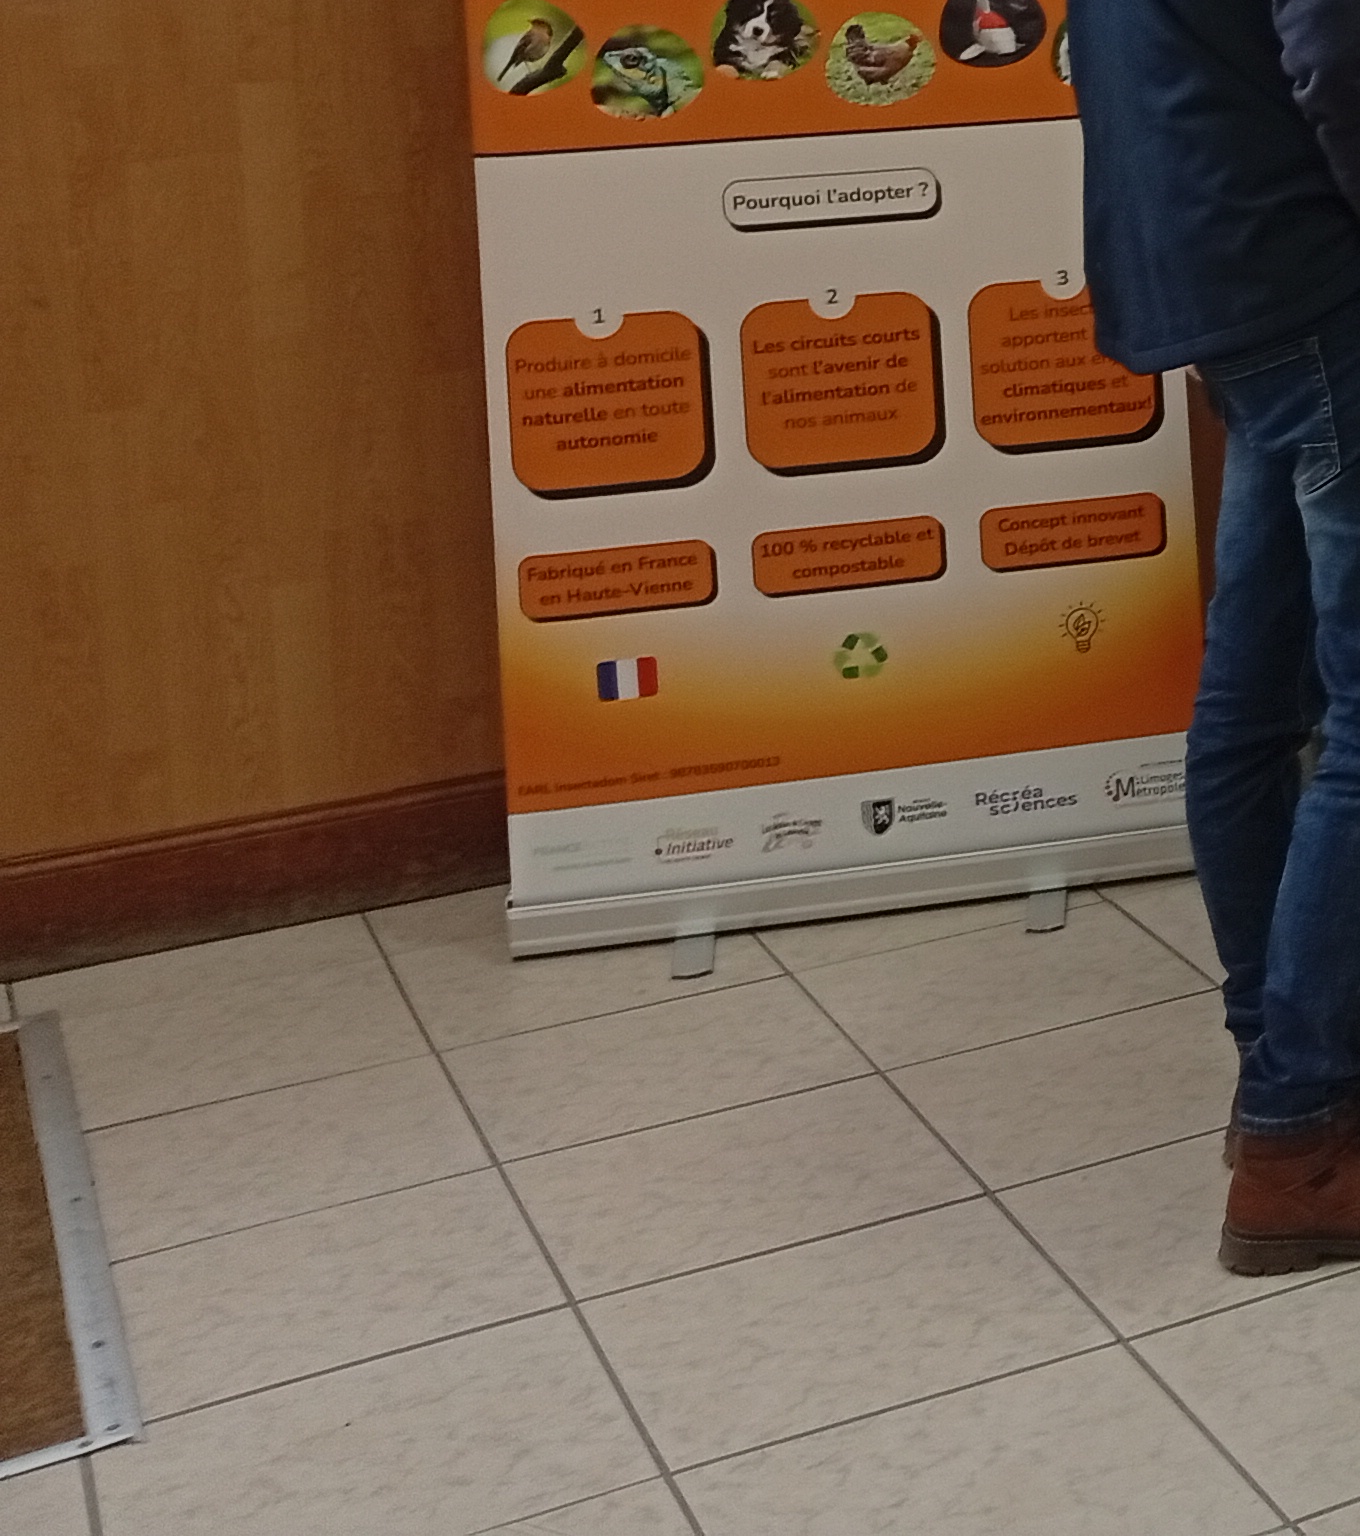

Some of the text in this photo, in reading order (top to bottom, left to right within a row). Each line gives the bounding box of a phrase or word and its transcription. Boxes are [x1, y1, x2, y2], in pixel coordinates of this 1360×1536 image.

[732, 181, 930, 212] Pourquoi l'adopter ?
[1056, 269, 1070, 286] 3
[826, 288, 839, 305] 2
[592, 308, 606, 325] 1
[1008, 306, 1040, 322] Les
[752, 327, 921, 356] Les circuits courts
[1002, 327, 1089, 350] apportent
[514, 345, 694, 374] Produire à domicile
[767, 353, 909, 381] sont l'avenir de
[979, 356, 1051, 376] solution
[1055, 355, 1087, 369] aux
[524, 374, 685, 400] une alimentation
[761, 378, 919, 407] l'alimentation de
[1003, 374, 1129, 399] climatiques et
[522, 400, 691, 428] naturelle en toute
[784, 407, 899, 430] nos animaux
[980, 395, 1154, 427] environnementaux!
[556, 428, 659, 452] autonomie
[998, 505, 1146, 534] Concept innovant
[761, 527, 935, 559] 100 % recyclable et
[1004, 530, 1142, 557] Dépôt de brevet
[526, 553, 698, 583] Fabriqué en France
[792, 554, 907, 580] compostable
[538, 577, 694, 607] en Haute-Vienne
[975, 784, 1044, 807] Récréa
